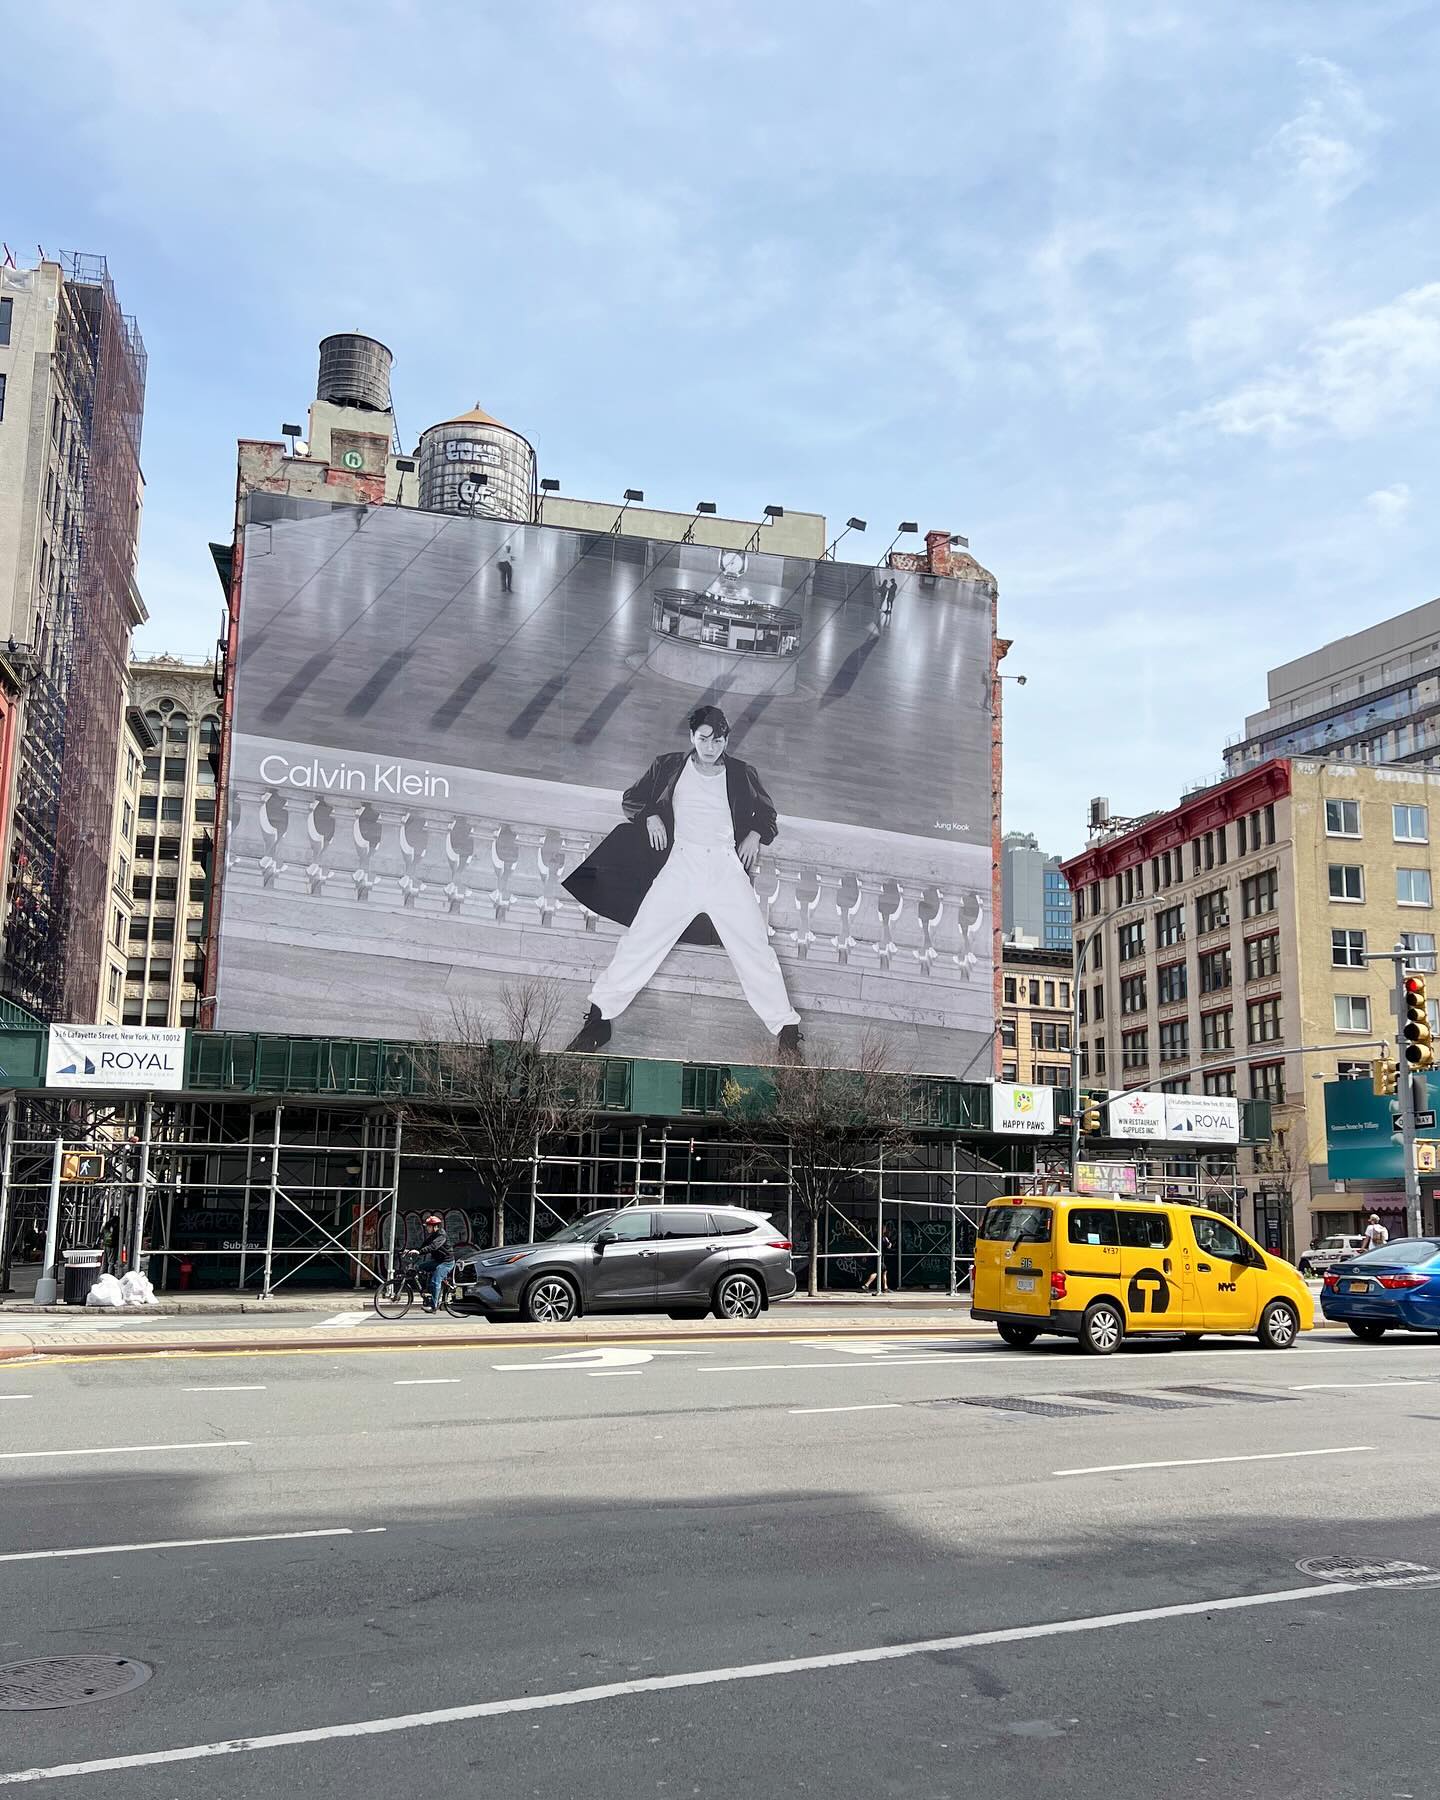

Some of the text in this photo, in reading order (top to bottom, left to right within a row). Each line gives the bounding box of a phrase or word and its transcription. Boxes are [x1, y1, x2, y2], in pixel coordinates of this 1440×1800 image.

[259, 755, 450, 798] Calvin Klein
[934, 820, 970, 831] Jung Kook
[67, 1030, 98, 1041] Lafayette
[98, 1031, 119, 1041] Street,
[120, 1032, 134, 1040] New
[162, 1034, 181, 1043] 10012
[101, 1051, 175, 1071] ROYAL
[1002, 1120, 1045, 1130] HAPPY PAWS
[1195, 1114, 1235, 1129] ROYAL
[1122, 1126, 1145, 1134] SUPPLIES
[1103, 1247, 1119, 1255] 4Y37
[1218, 1282, 1236, 1292] NYC
[1136, 1279, 1161, 1314] T
